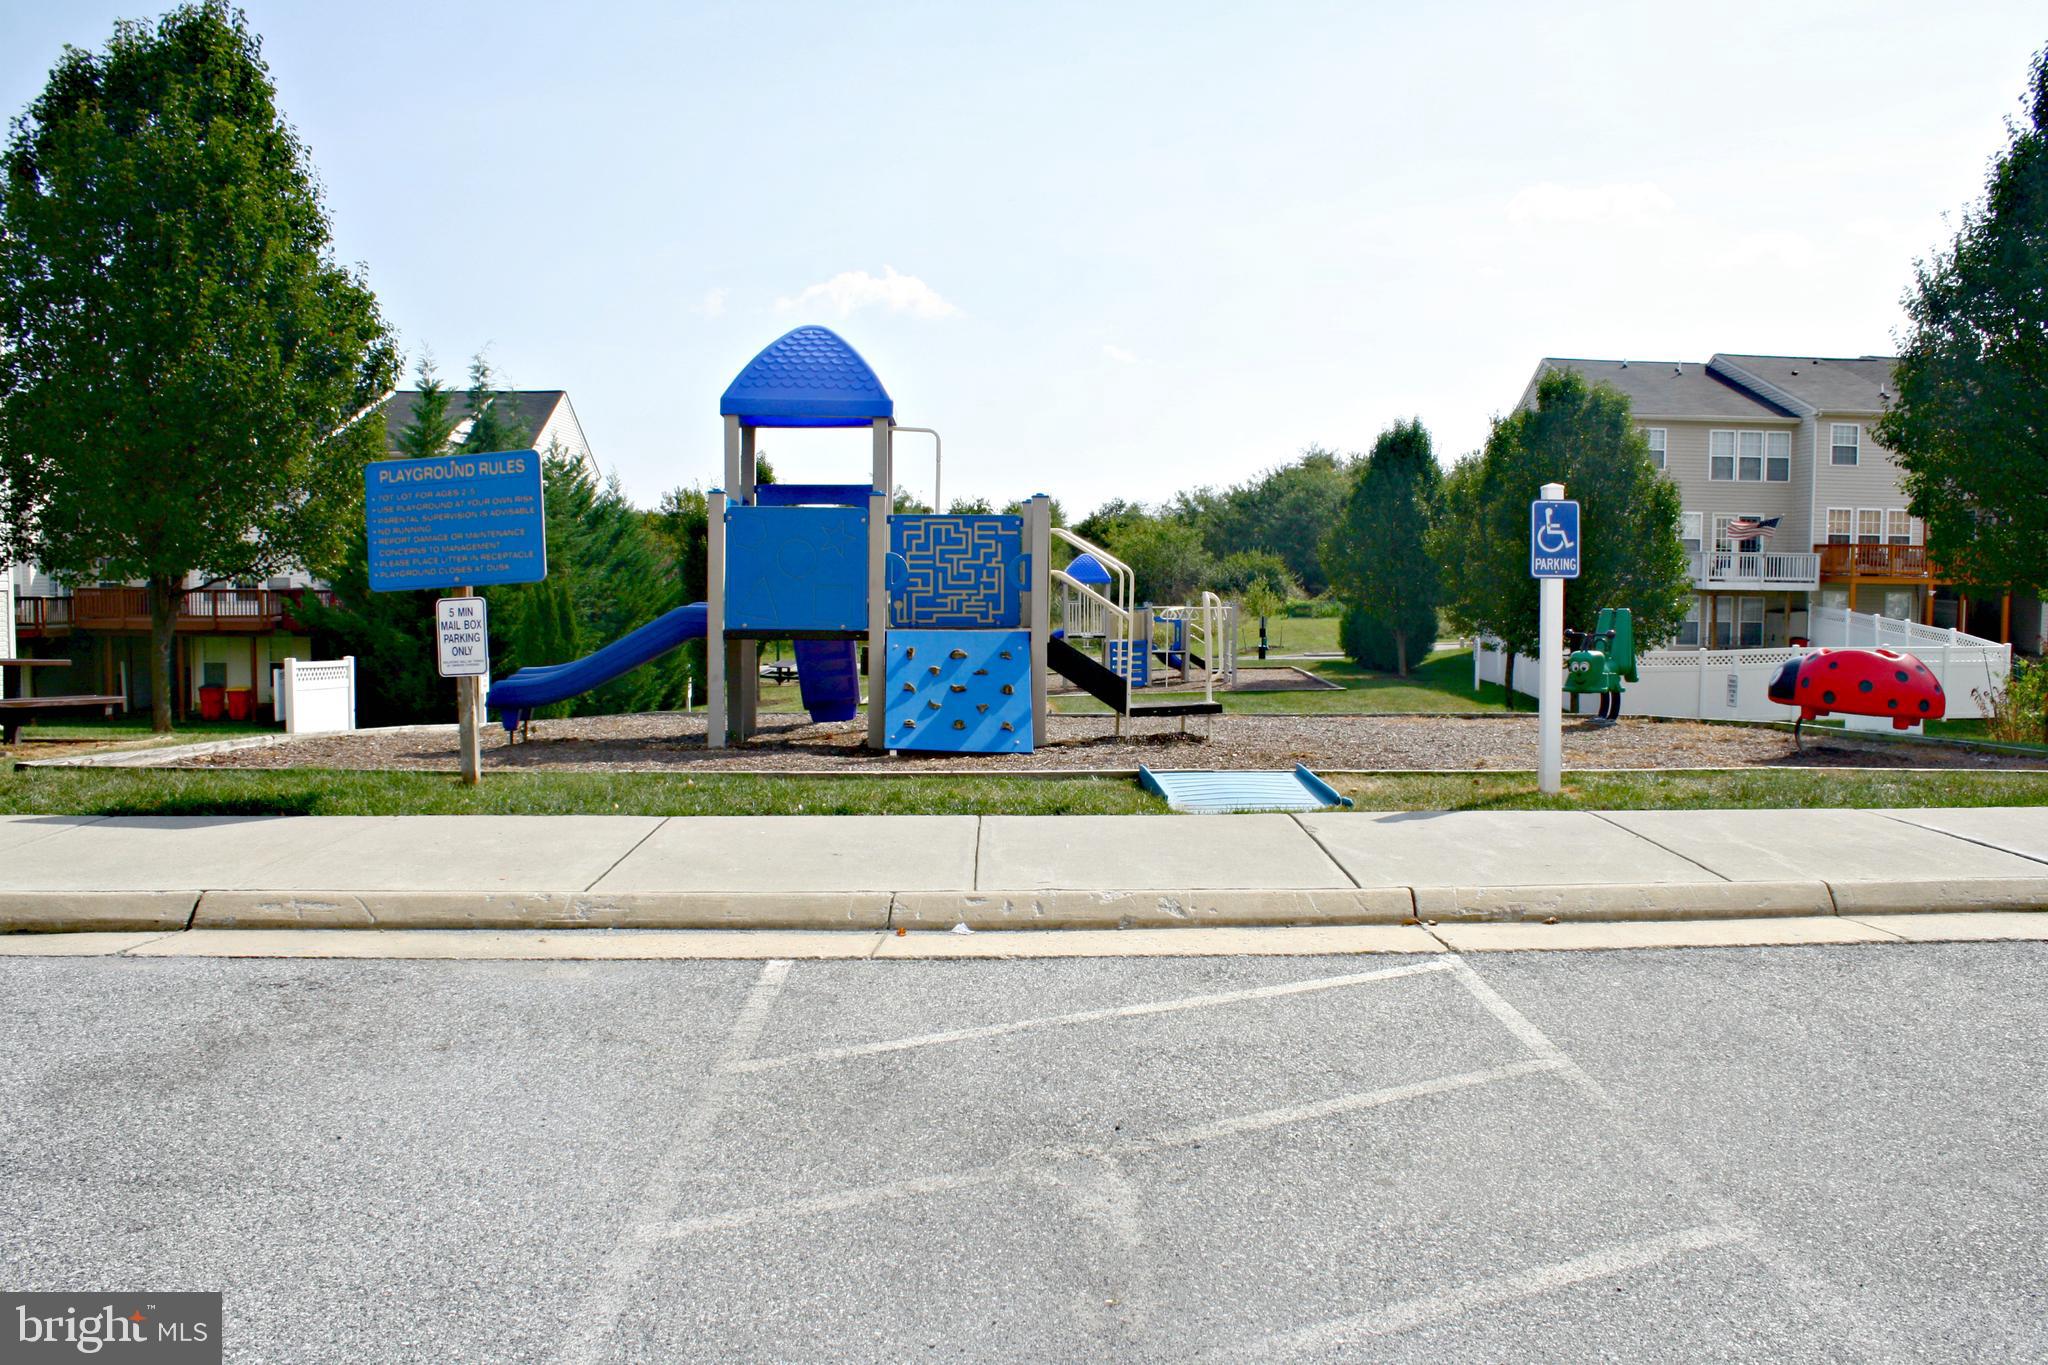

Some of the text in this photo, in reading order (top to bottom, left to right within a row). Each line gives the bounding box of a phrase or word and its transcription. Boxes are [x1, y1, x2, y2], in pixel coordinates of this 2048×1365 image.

[379, 458, 525, 484] PLAYGROUND RULES
[379, 494, 393, 502] TOT
[397, 492, 412, 501] LOT
[415, 490, 433, 499] FOR
[435, 488, 459, 497] AGES
[378, 495, 533, 514] USE PLAYGROUND AT YOUR OWN RISK
[378, 506, 535, 525] PARENTAL SUPERVISION IS ADVISABLE
[378, 525, 432, 536] NO RUNNING
[378, 528, 526, 546] REPORT DAMAGE OR MAINTENANCE
[379, 540, 501, 557] CONCERNS TO MANAGEMENT
[379, 550, 534, 568] PLEASE PLACE LITTER IN RECEPTACLE
[1535, 557, 1577, 571] PARKING
[380, 563, 510, 578] PLAYGROUND CLOSES AT DUSK
[449, 607, 473, 617] 5 MIN
[441, 620, 482, 631] MAIL BOX
[444, 632, 480, 643] PARKING
[452, 646, 473, 656] ONLY
